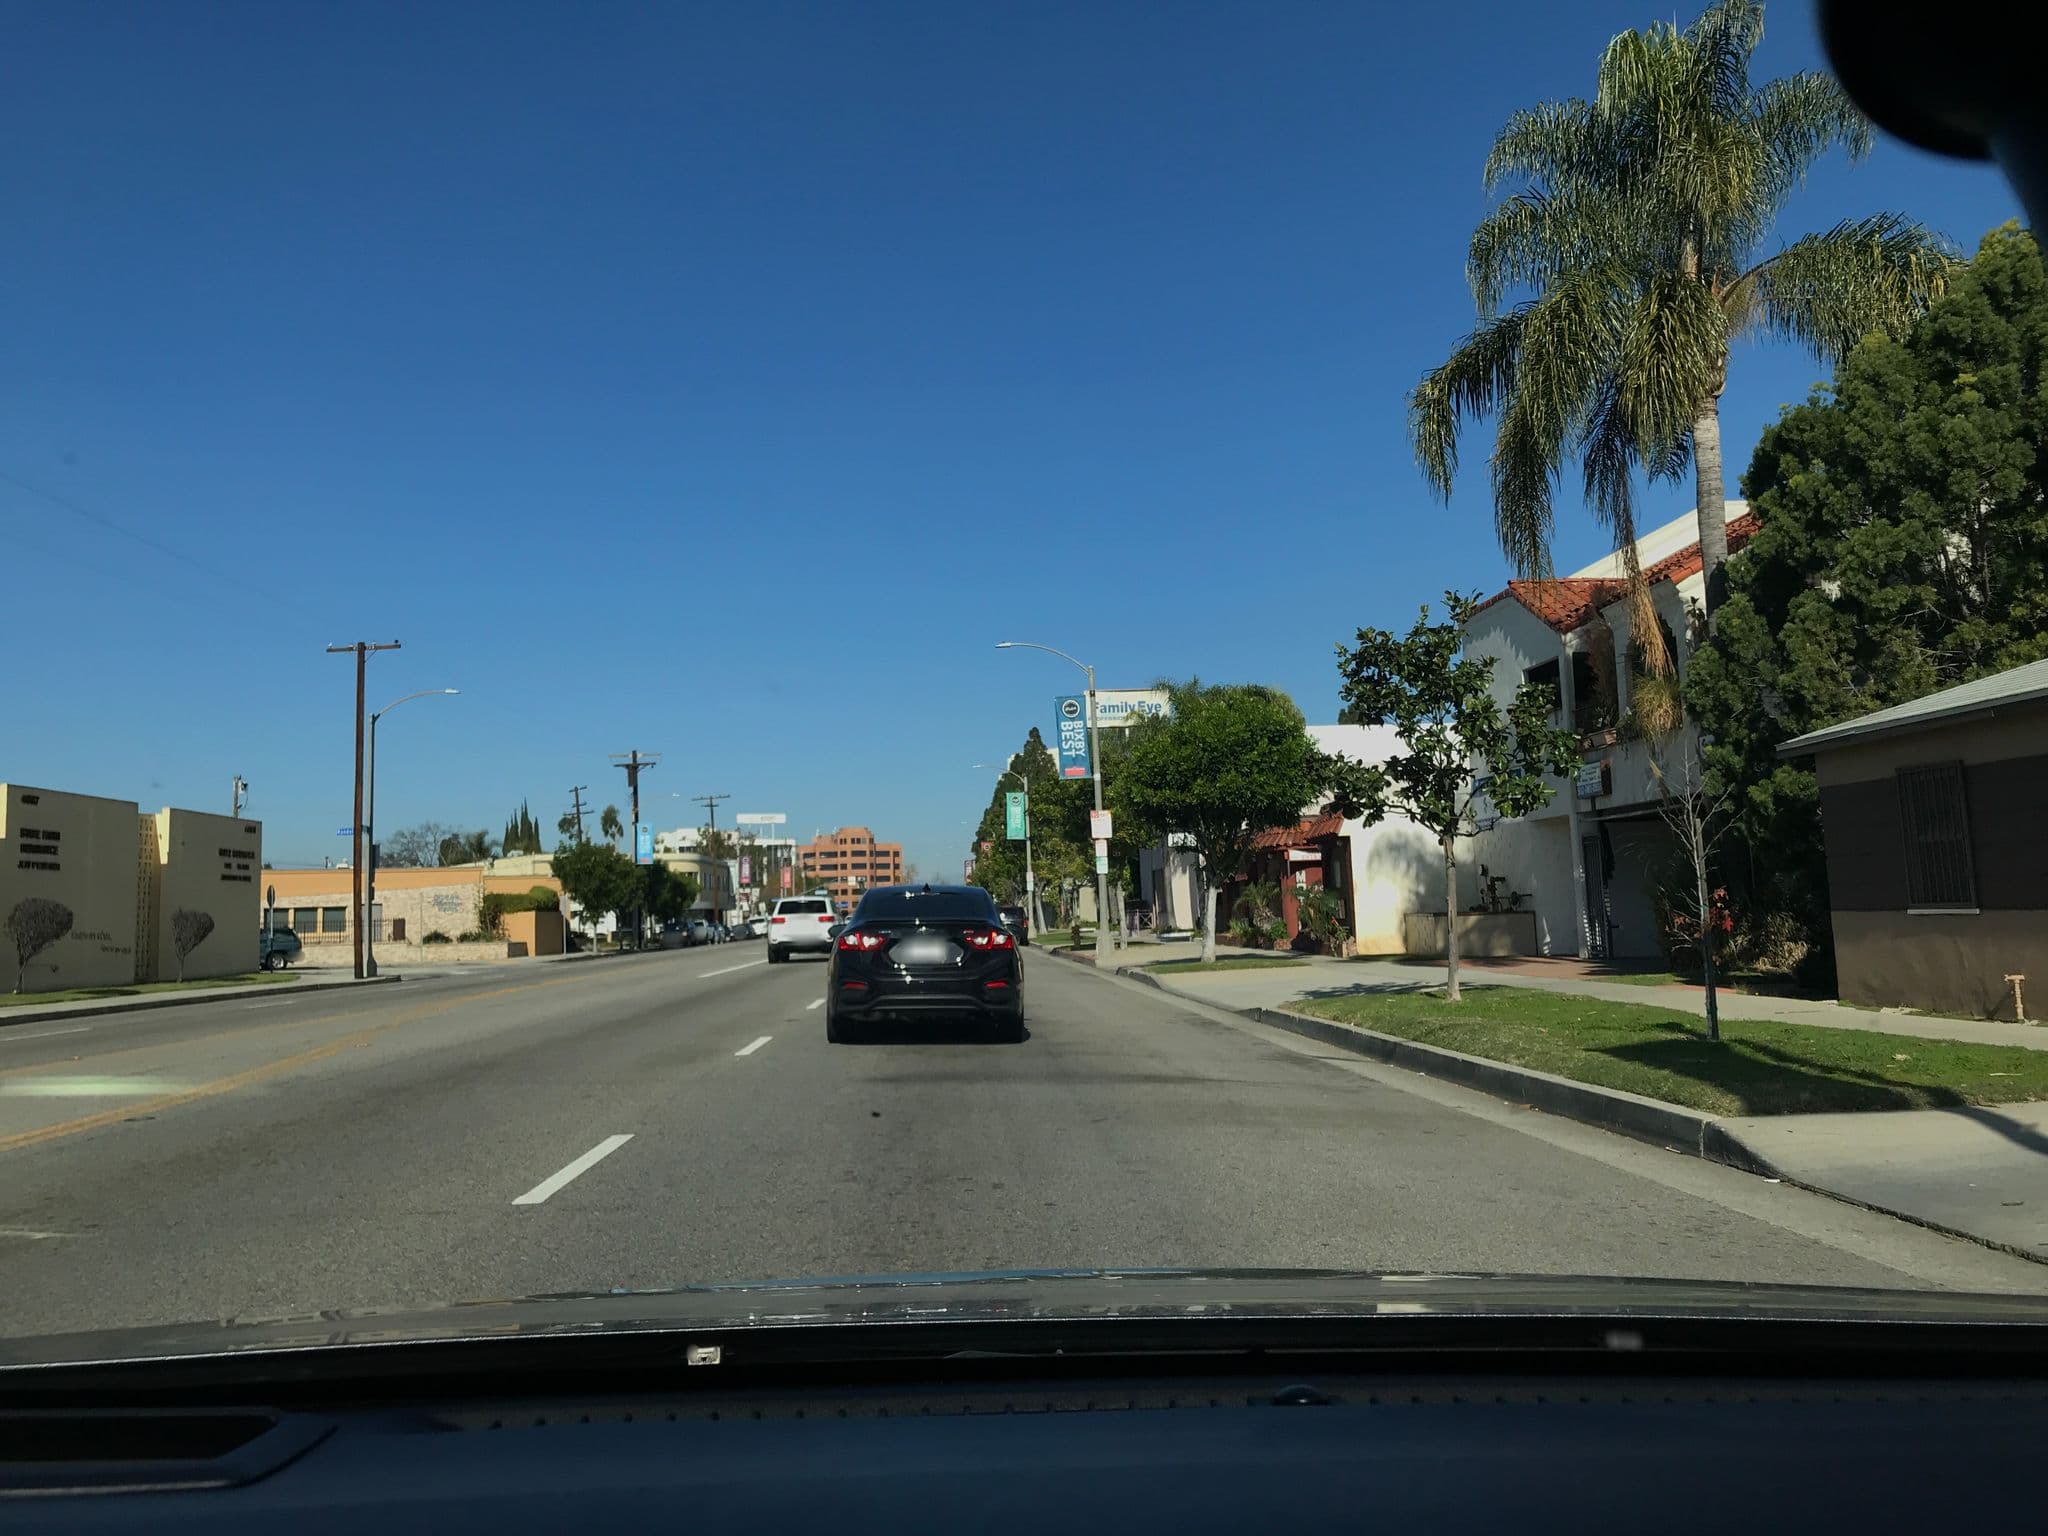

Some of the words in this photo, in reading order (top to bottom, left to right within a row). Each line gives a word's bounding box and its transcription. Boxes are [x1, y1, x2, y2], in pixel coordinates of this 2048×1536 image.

[1137, 701, 1162, 715] Eye
[1061, 721, 1076, 758] BEST
[1073, 720, 1086, 757] BIXBY
